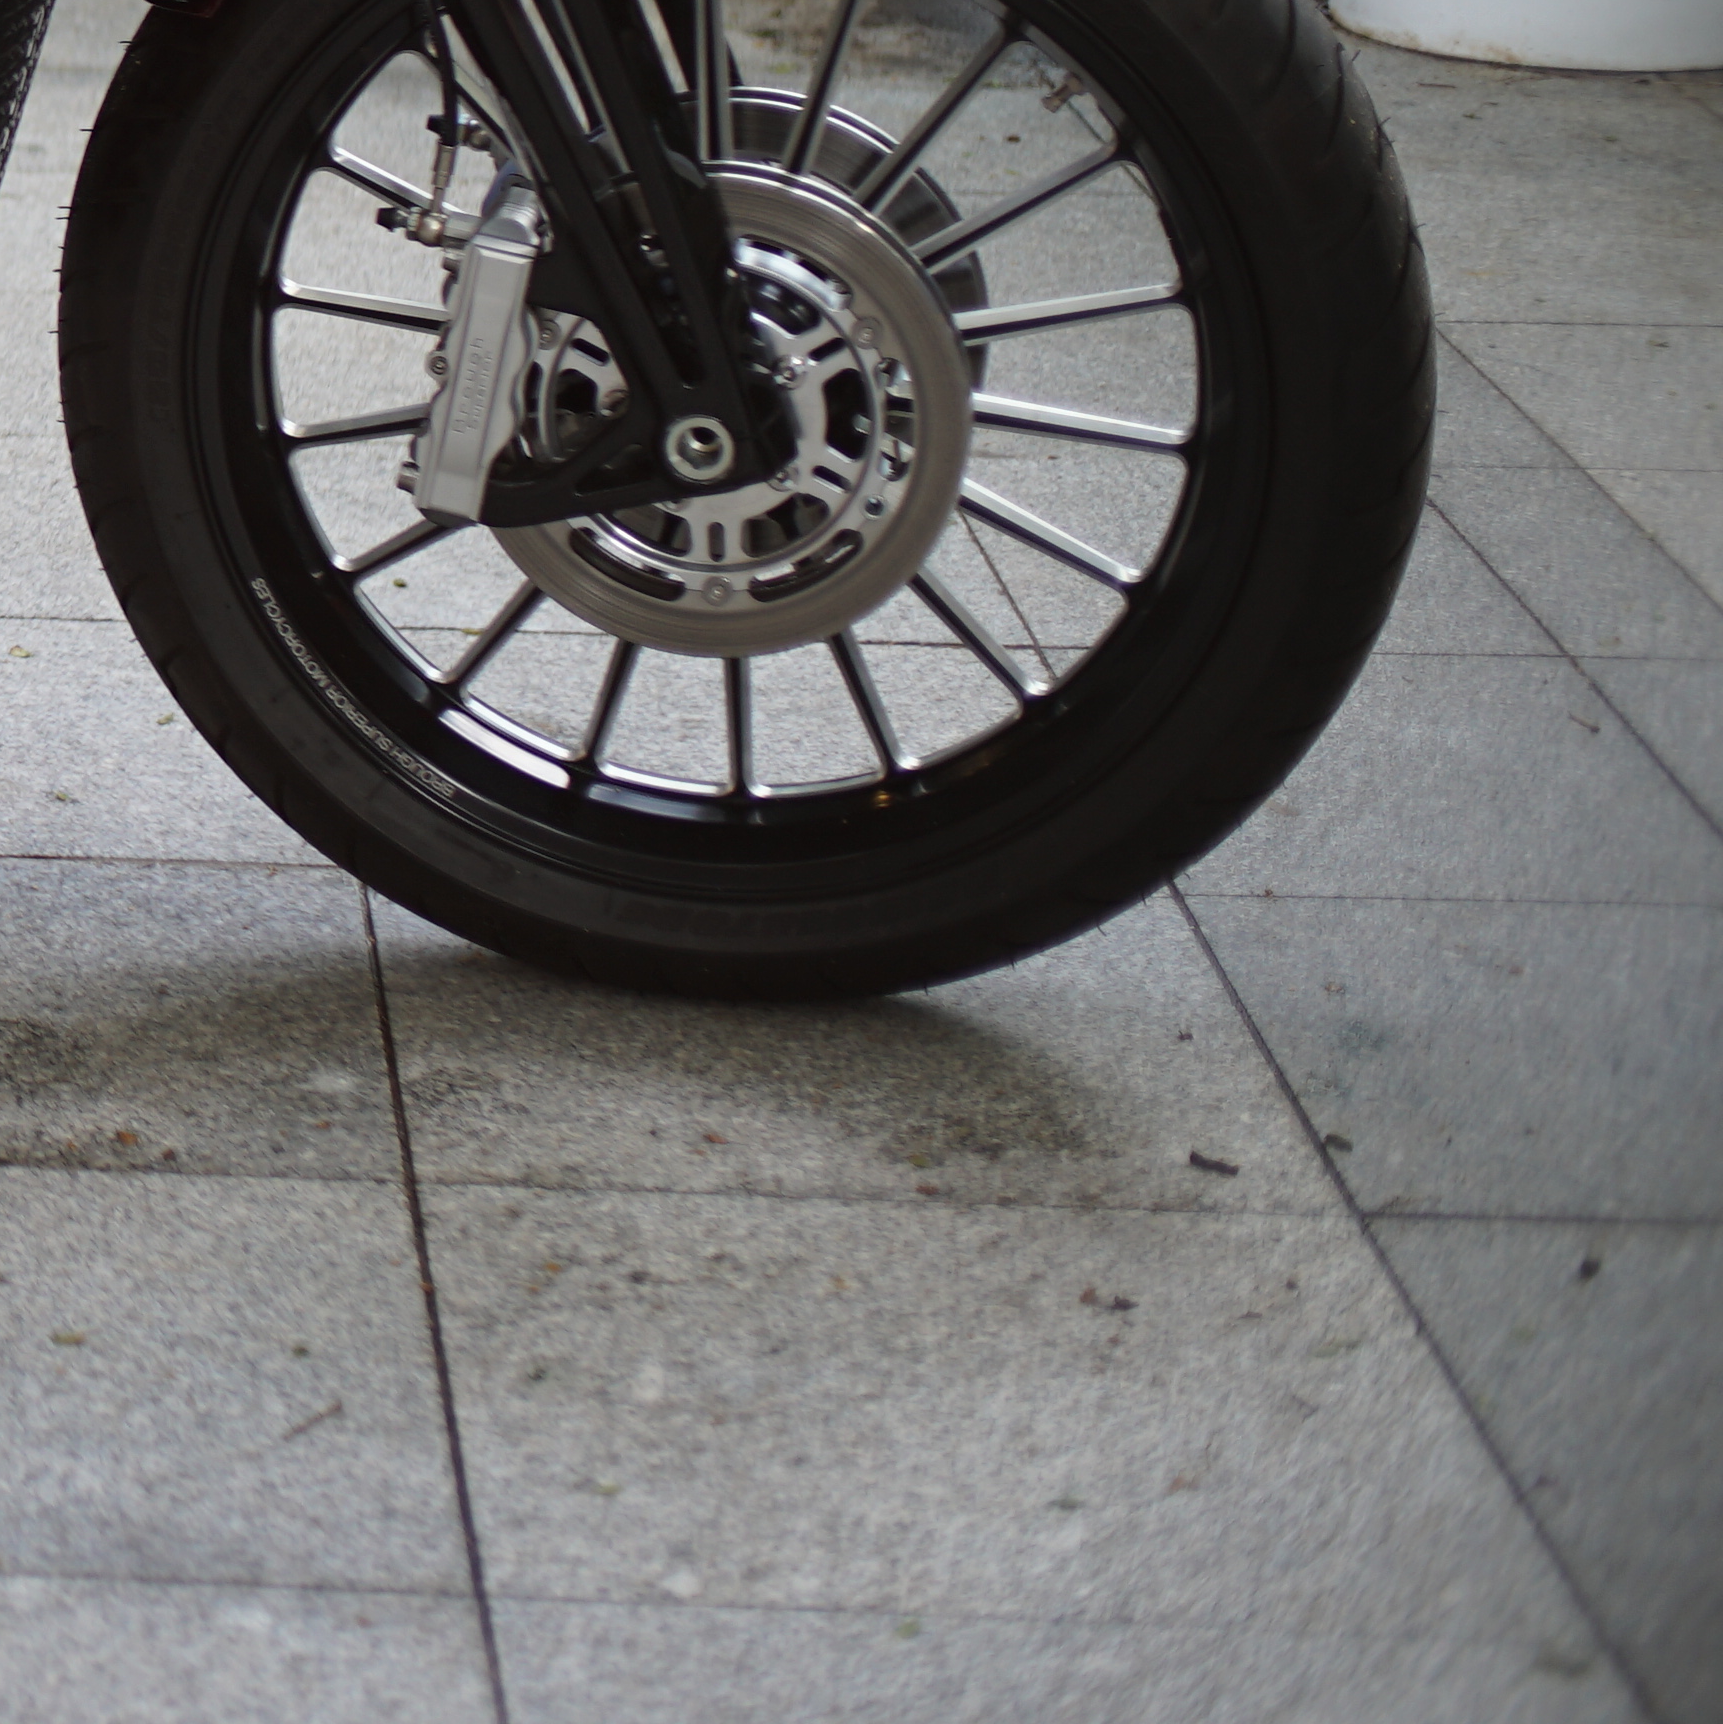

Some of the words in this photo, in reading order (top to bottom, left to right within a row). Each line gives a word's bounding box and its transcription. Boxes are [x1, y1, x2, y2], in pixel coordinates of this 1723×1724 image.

[250, 576, 331, 688] MOTORCYCLES
[325, 684, 394, 752] SUPERIOR
[388, 746, 456, 798] BROUGH
